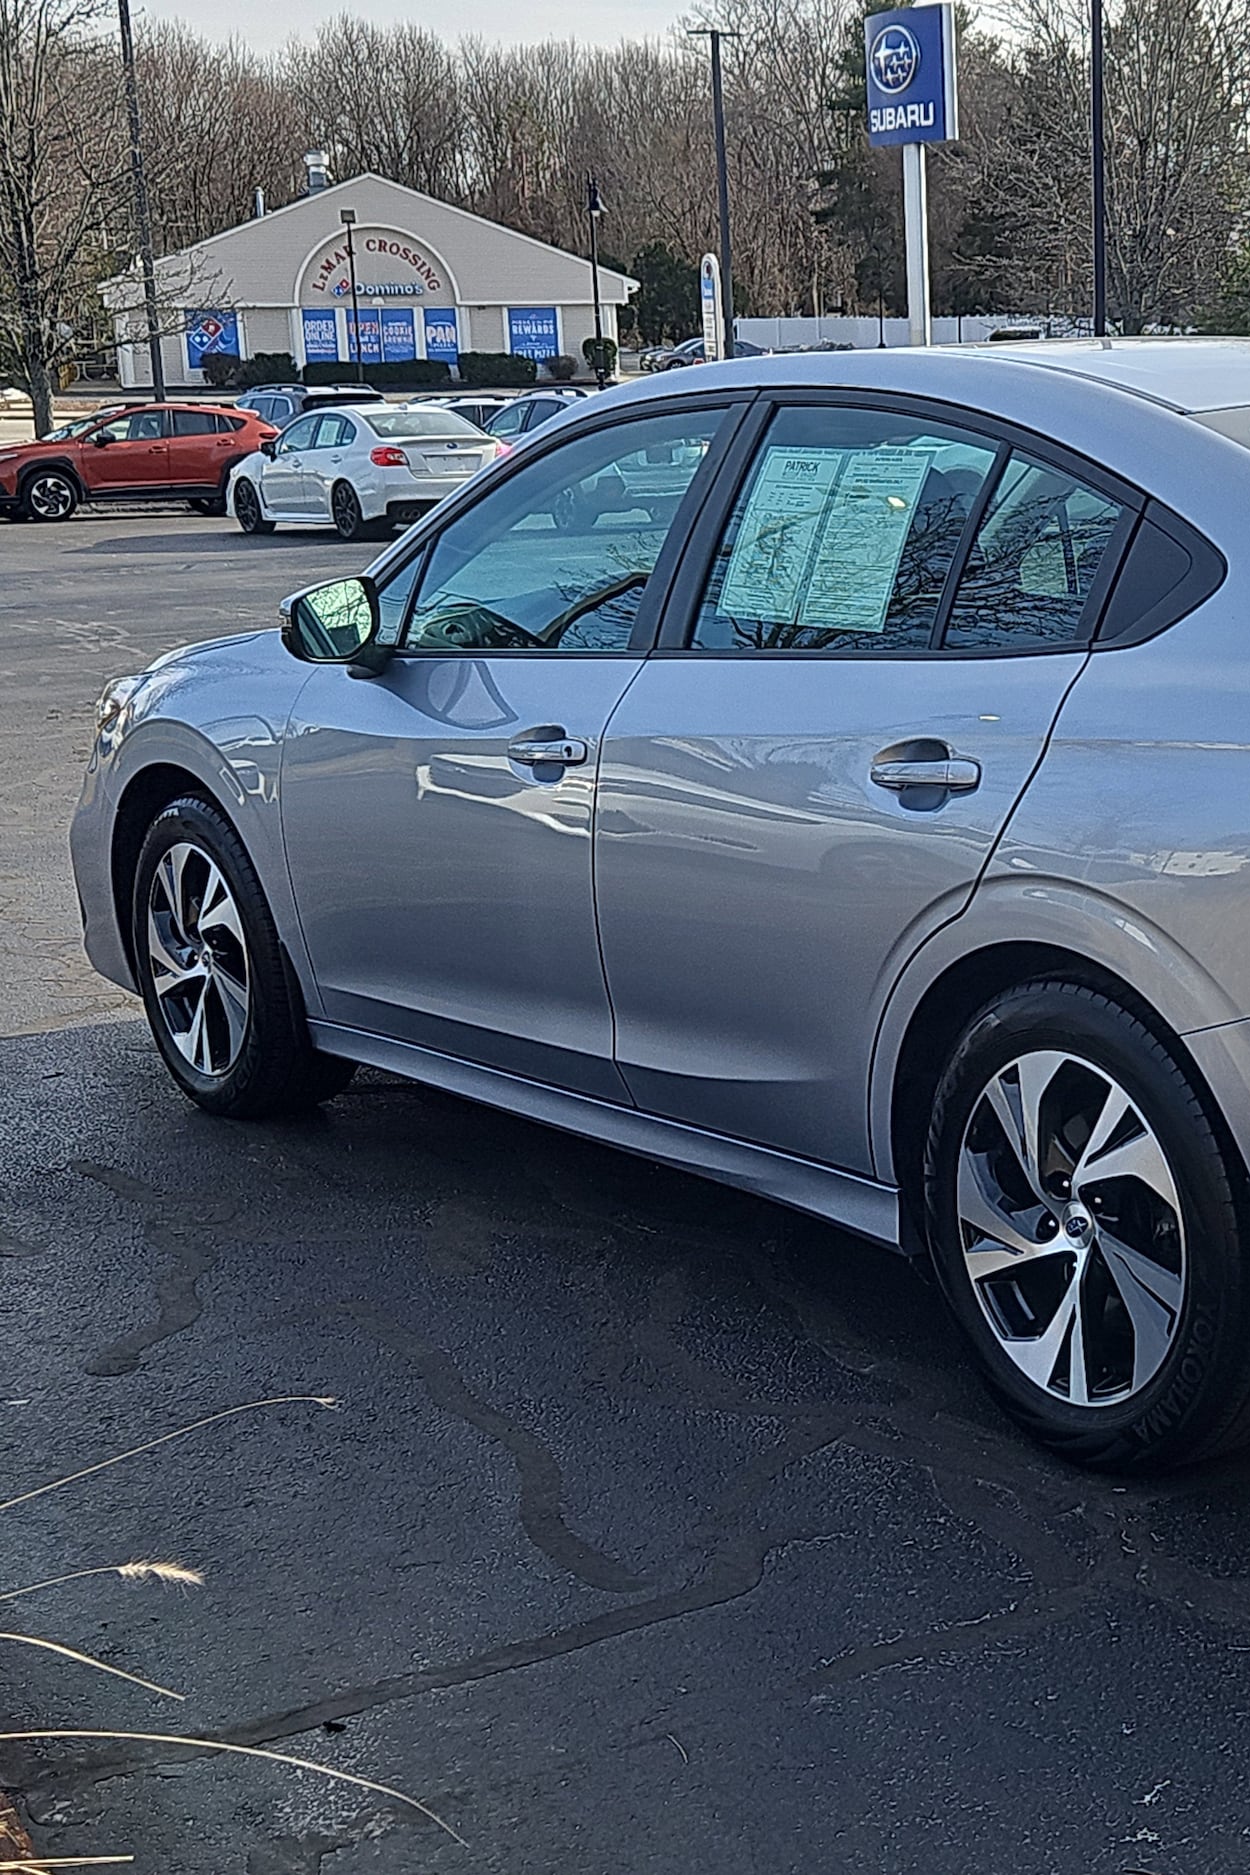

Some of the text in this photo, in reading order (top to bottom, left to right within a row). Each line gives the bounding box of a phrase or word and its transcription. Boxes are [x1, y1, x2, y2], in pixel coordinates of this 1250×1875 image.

[870, 102, 934, 133] SUBARU
[365, 238, 440, 291] CROSSING
[355, 281, 423, 295] Domino's
[304, 320, 335, 331] ORDER
[512, 324, 554, 335] REWARDS
[305, 331, 335, 341] ONLINE
[426, 326, 456, 344] PAN
[784, 460, 820, 473] PATRICK
